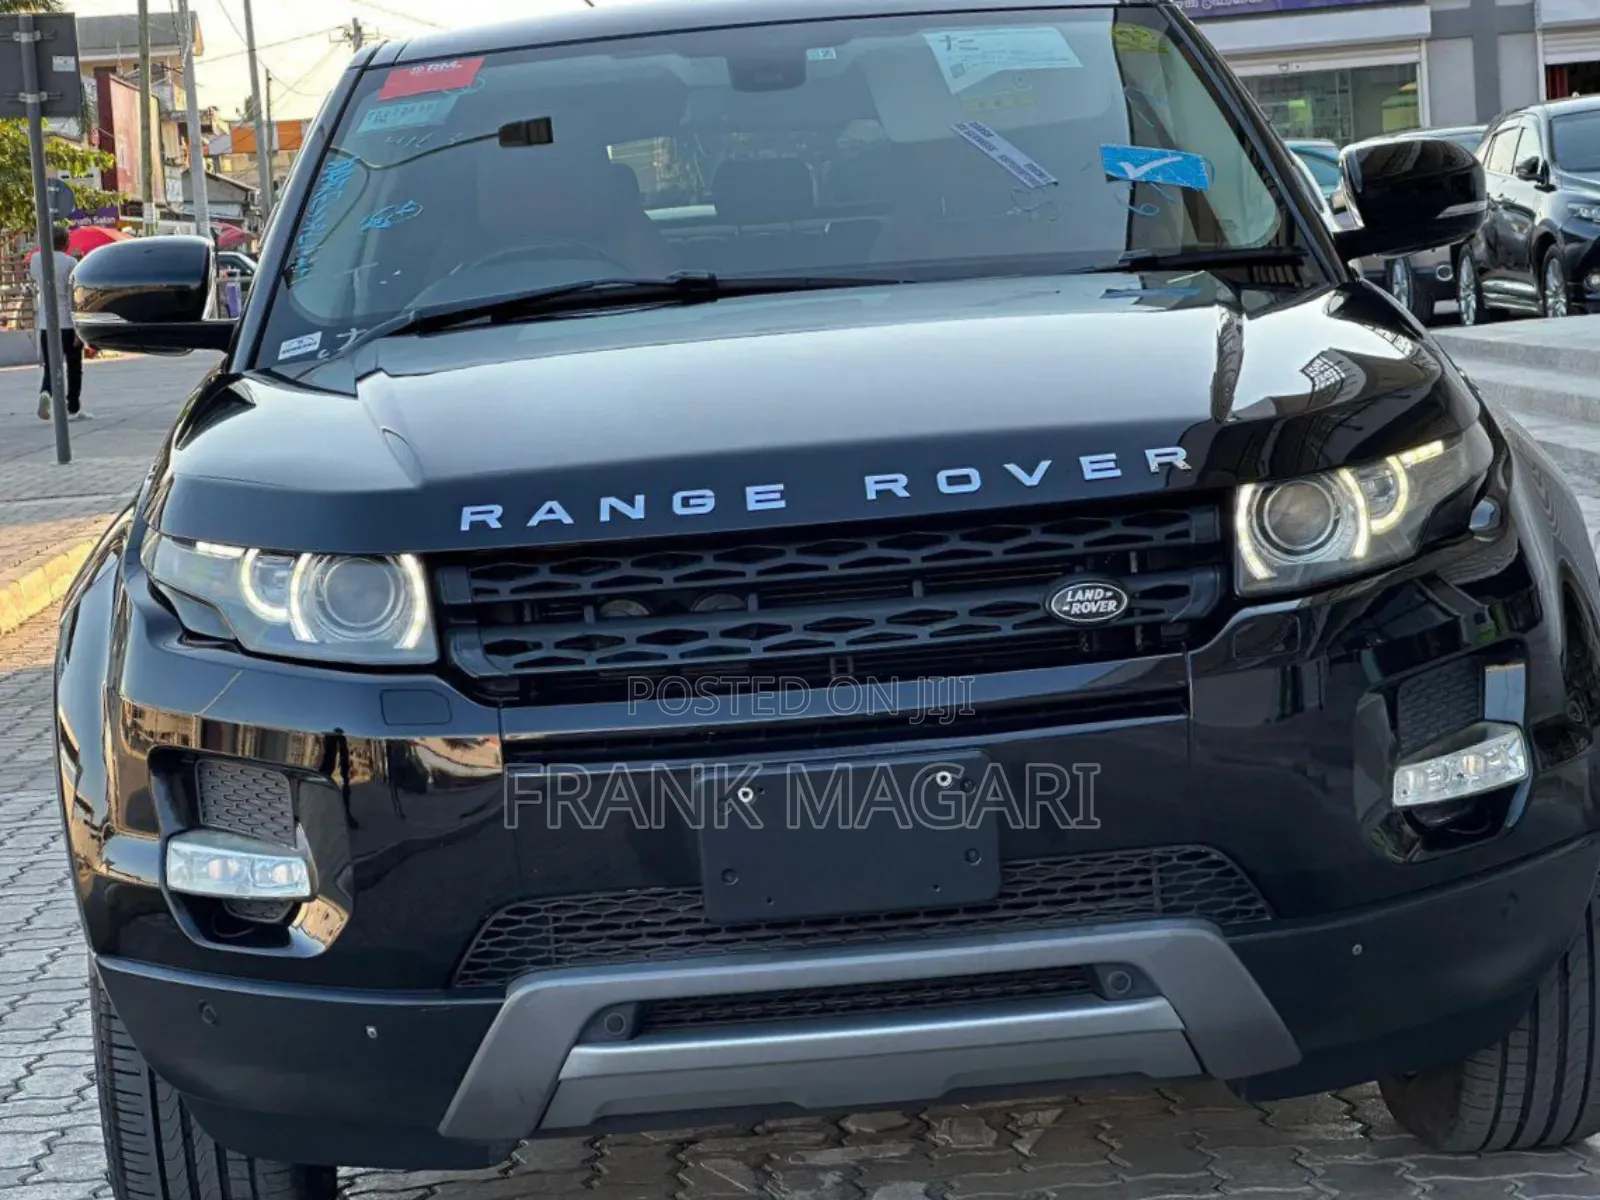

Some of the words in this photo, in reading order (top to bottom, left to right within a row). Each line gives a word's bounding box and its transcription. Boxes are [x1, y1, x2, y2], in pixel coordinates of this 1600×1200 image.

[460, 483, 787, 531] RANGE
[864, 446, 1192, 500] ROVER
[1066, 588, 1105, 602] LAND
[1070, 600, 1117, 614] ROVER
